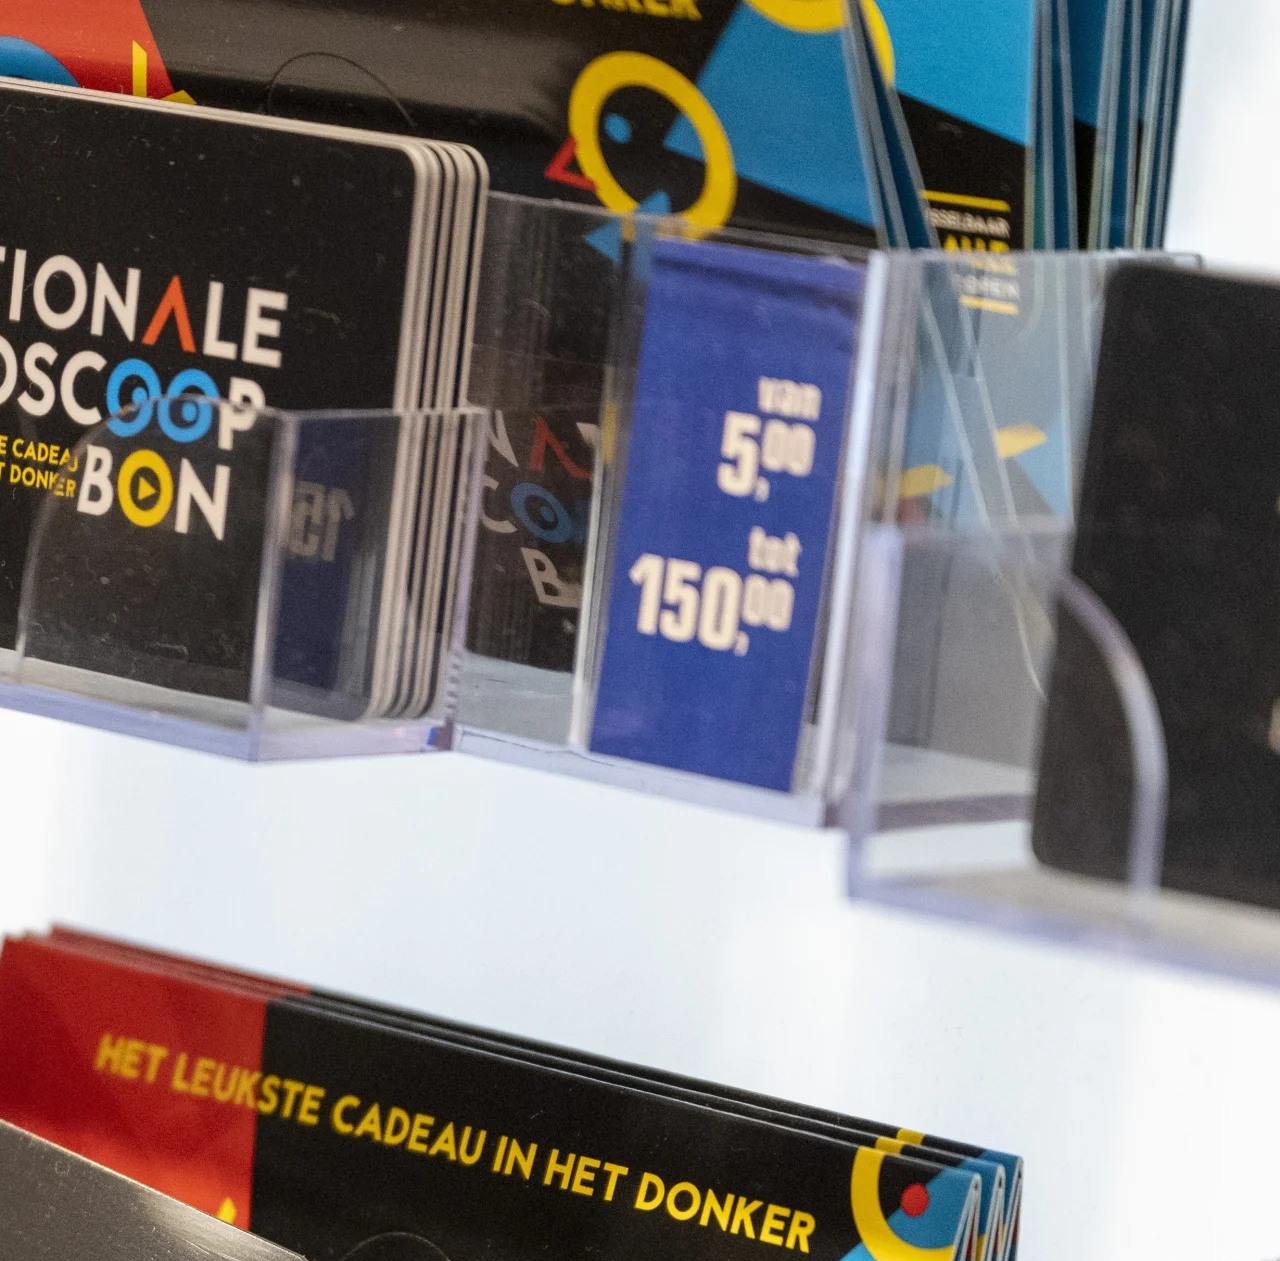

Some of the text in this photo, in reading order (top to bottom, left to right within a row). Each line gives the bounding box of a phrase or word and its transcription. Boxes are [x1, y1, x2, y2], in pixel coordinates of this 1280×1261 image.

[757, 375, 823, 422] van
[9, 463, 77, 498] DONKER
[12, 438, 79, 473] CADEAU
[716, 409, 817, 503] 5,00
[77, 445, 230, 541] BON
[748, 526, 803, 578] tot
[628, 552, 796, 657] 150,00
[94, 1032, 816, 1255] HET LEUKSTE CADEAU IN HET DONKER
